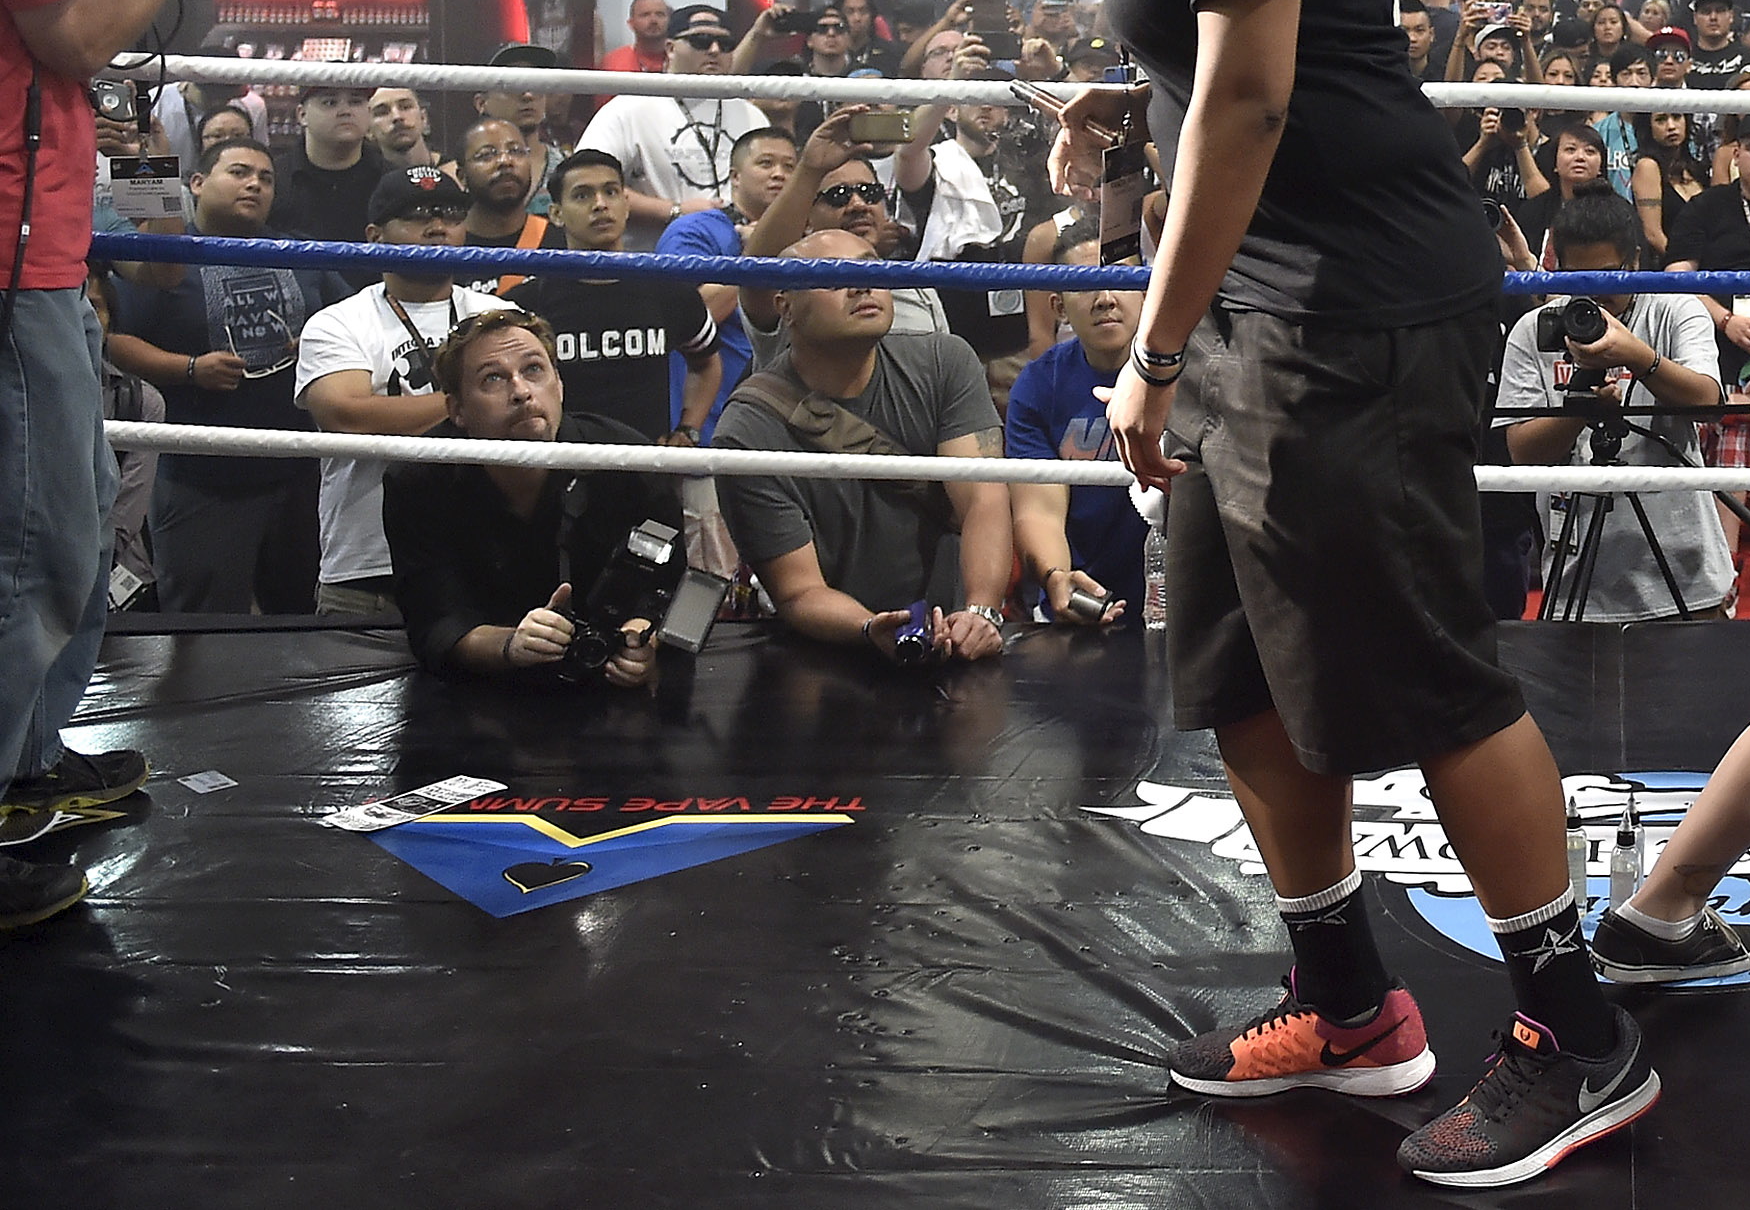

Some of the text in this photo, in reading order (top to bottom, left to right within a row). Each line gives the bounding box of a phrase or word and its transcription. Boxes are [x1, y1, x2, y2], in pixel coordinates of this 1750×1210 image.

[223, 293, 255, 308] ALL
[242, 322, 284, 339] NOW
[391, 337, 435, 361] INTEGA
[556, 328, 666, 361] OLCOM
[1059, 416, 1121, 461] NI
[470, 795, 867, 813] THE VAPE SUMM
